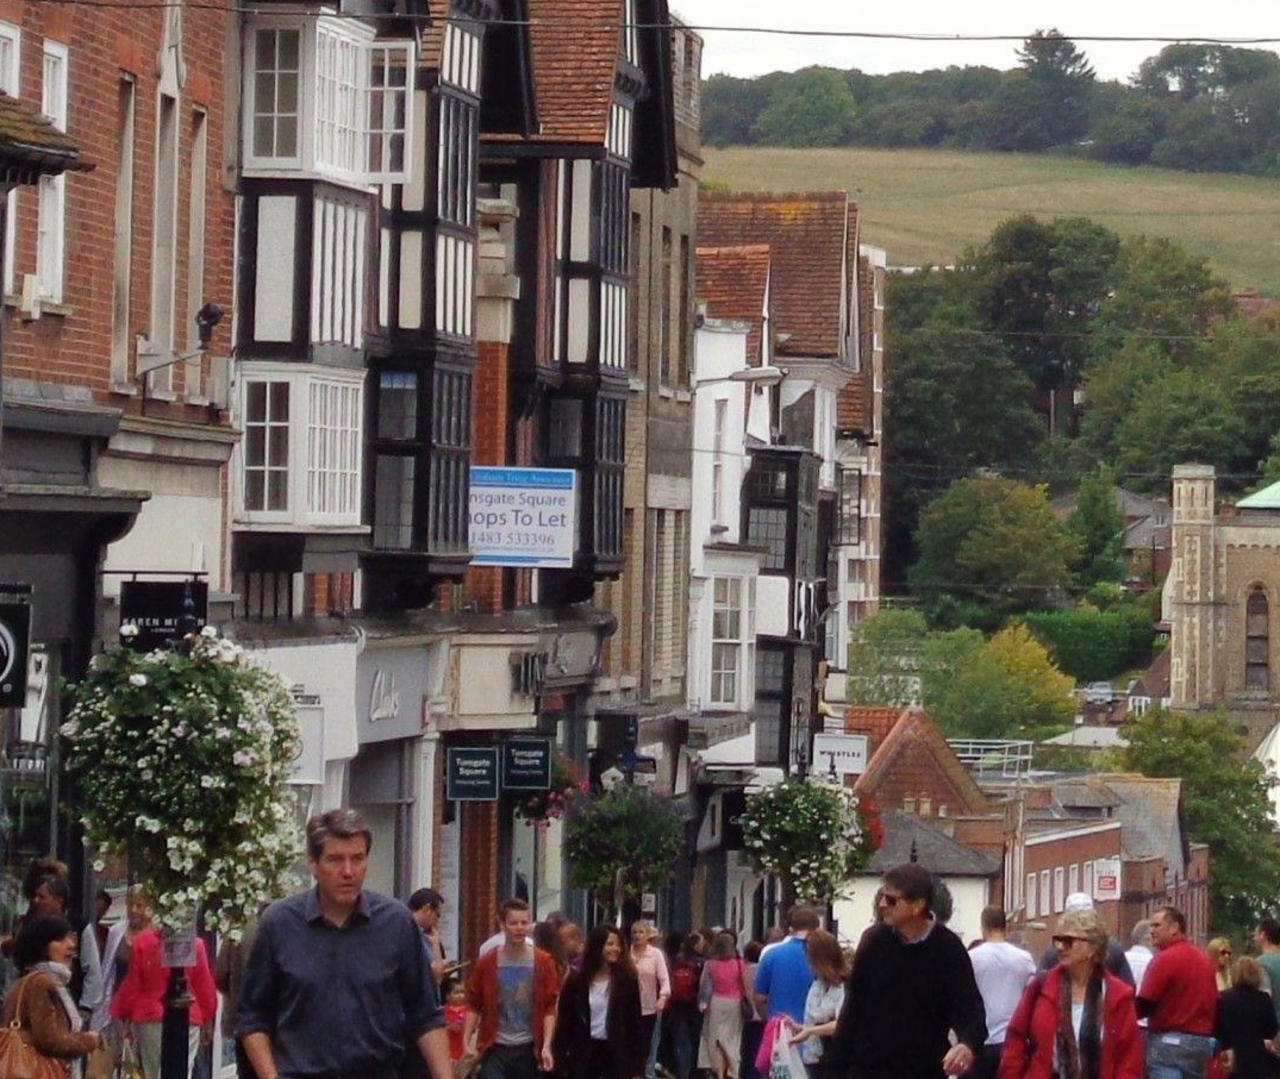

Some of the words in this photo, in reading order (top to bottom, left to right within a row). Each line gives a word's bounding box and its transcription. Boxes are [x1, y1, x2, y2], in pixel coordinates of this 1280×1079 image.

[518, 492, 567, 508] Square
[511, 509, 533, 527] To
[538, 510, 567, 528] Let
